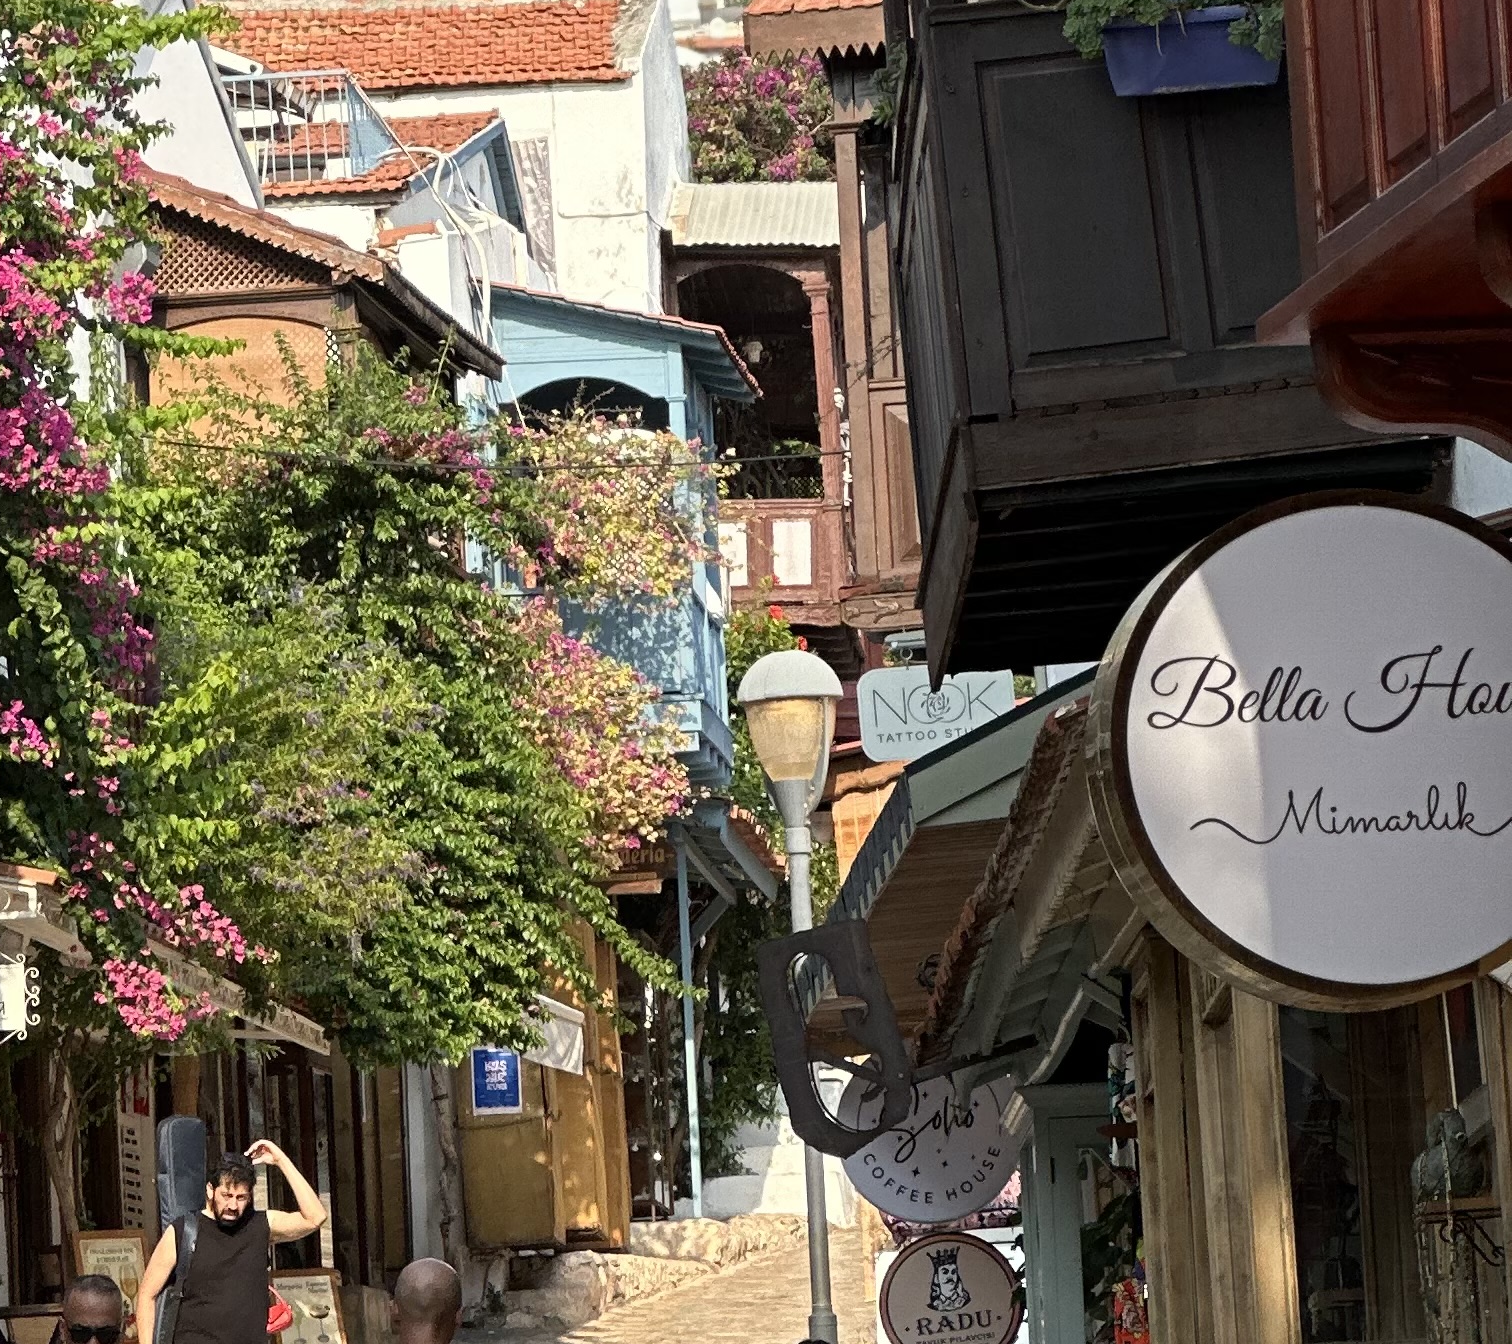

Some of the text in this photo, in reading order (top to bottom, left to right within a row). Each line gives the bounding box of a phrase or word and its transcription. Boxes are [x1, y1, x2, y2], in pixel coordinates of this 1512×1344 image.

[873, 680, 1000, 727] NOOK
[1147, 644, 1512, 733] Bella Hou
[877, 730, 937, 743] TATTOO
[863, 1146, 1001, 1205] COFFEE HOUSE
[916, 1309, 993, 1336] RADU
